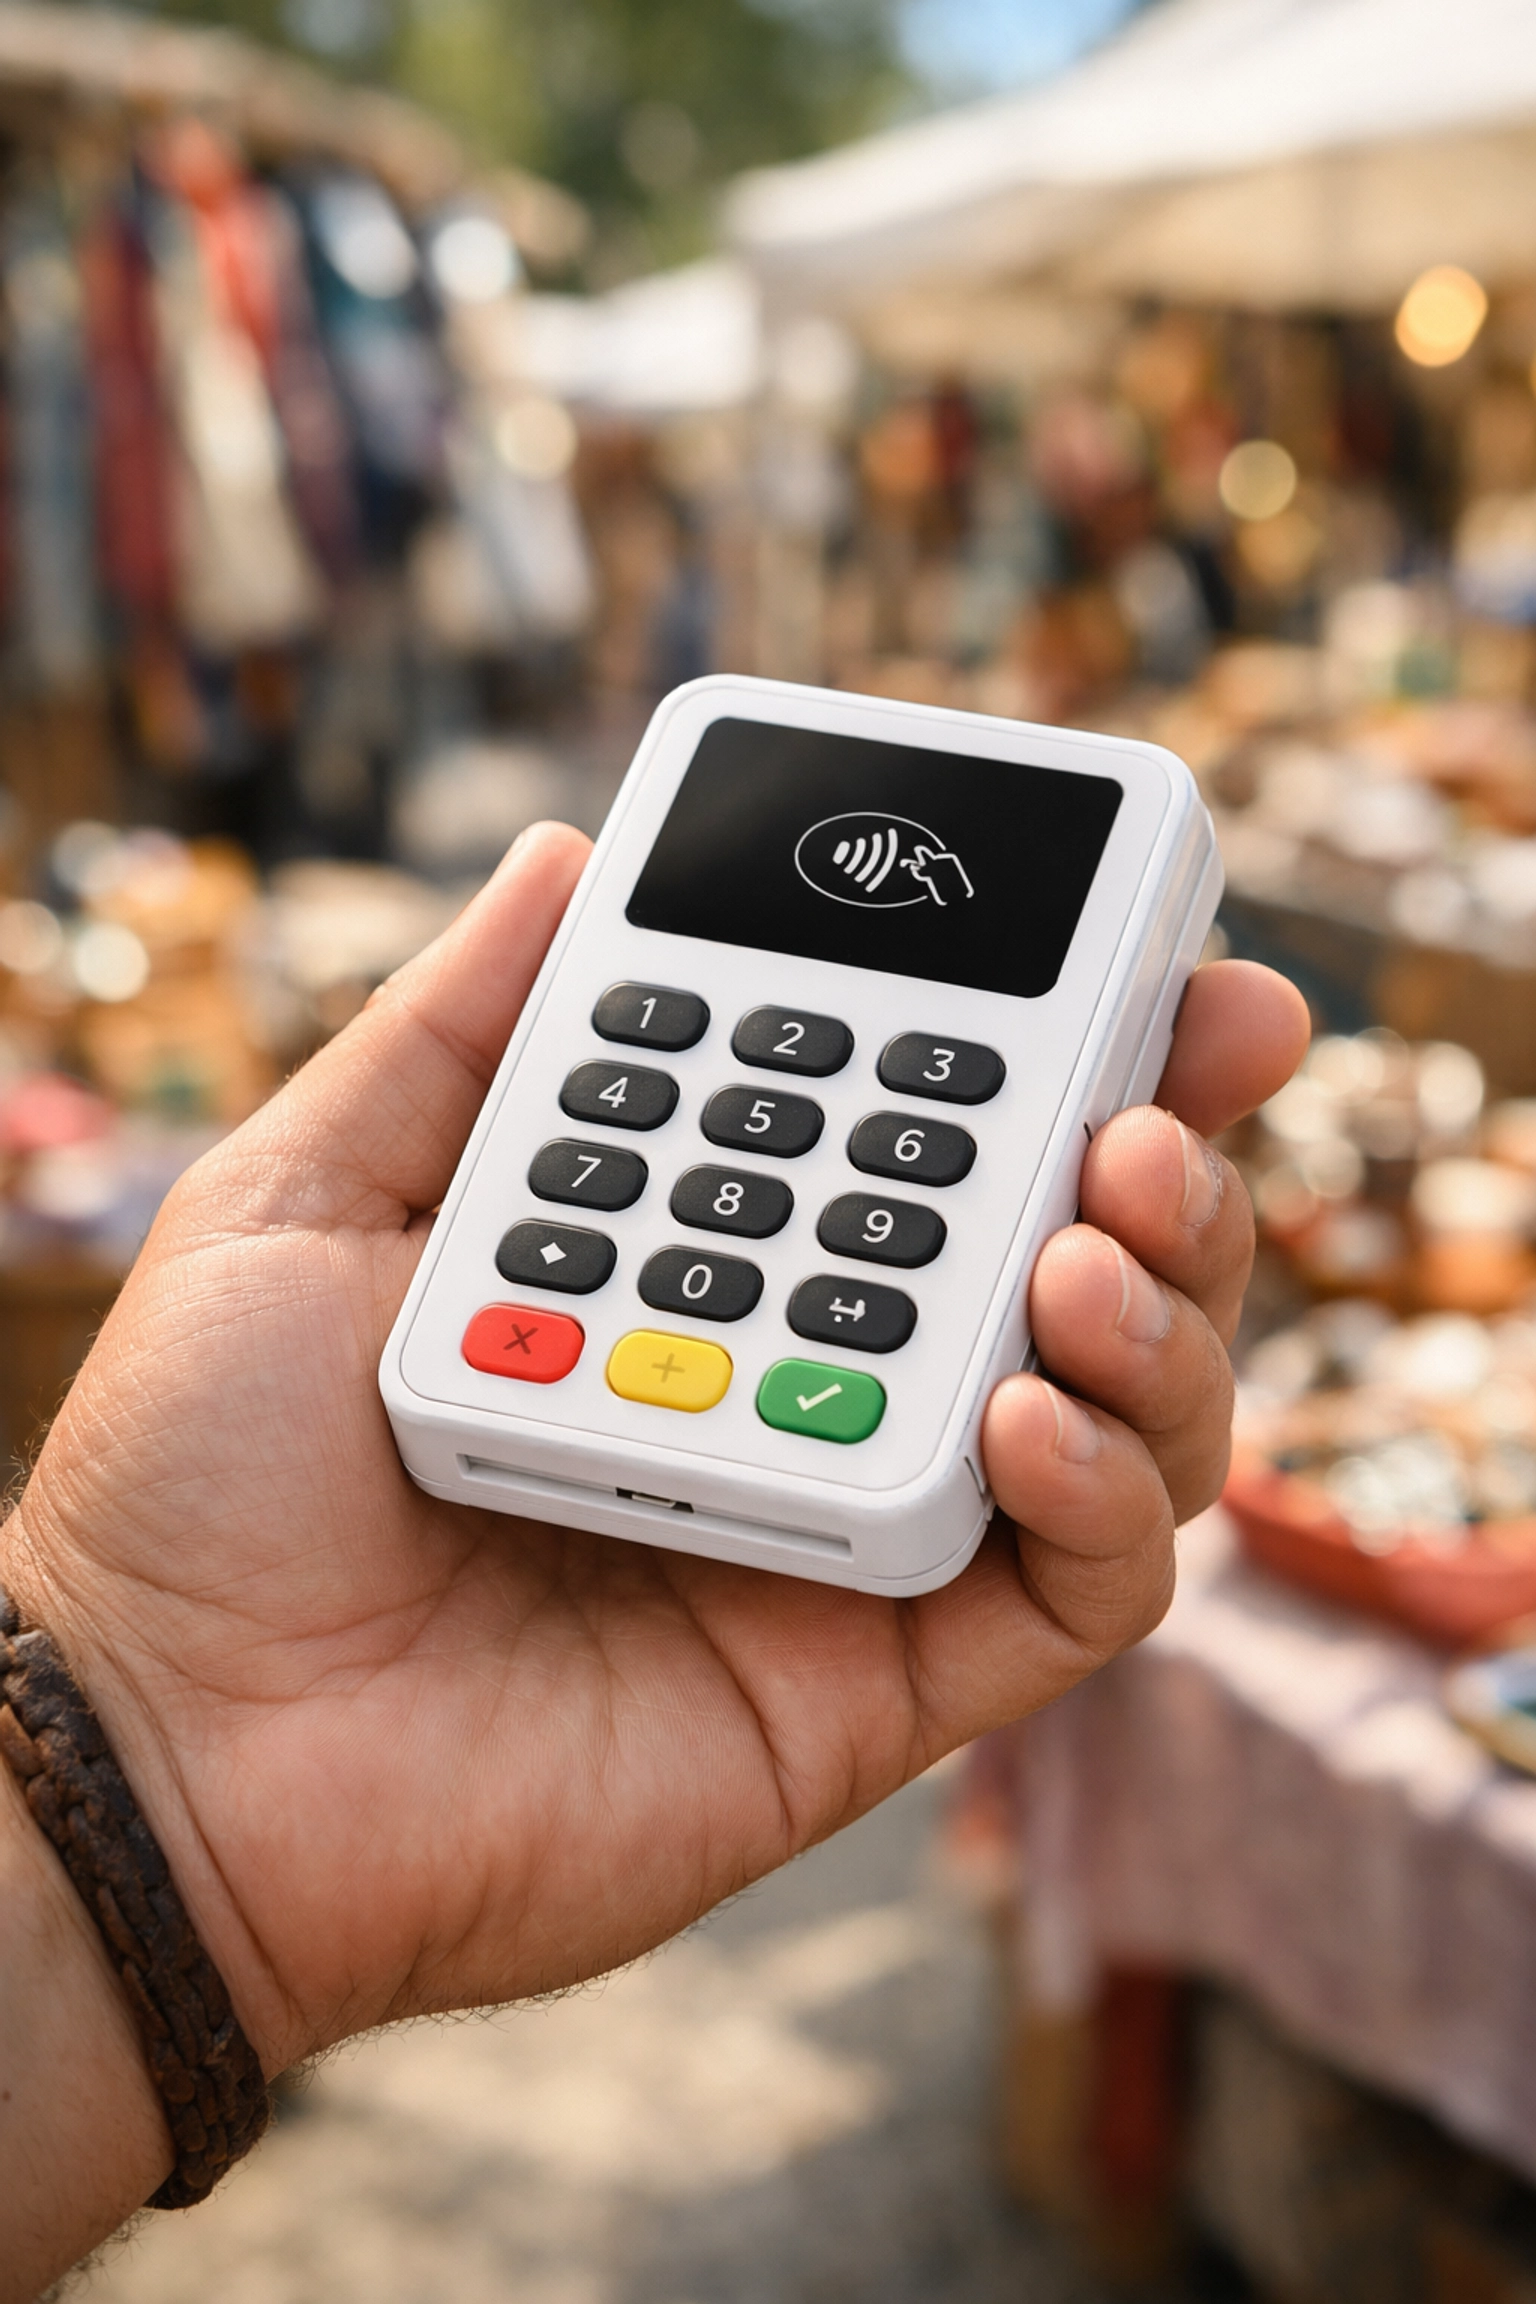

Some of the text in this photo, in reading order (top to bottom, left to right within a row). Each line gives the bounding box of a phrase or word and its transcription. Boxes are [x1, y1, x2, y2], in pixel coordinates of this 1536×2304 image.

[639, 997, 956, 1082] 1 2 3
[598, 1076, 926, 1162] 4 5 6
[571, 1154, 894, 1243] 7 8 9
[681, 1263, 713, 1300] 0
